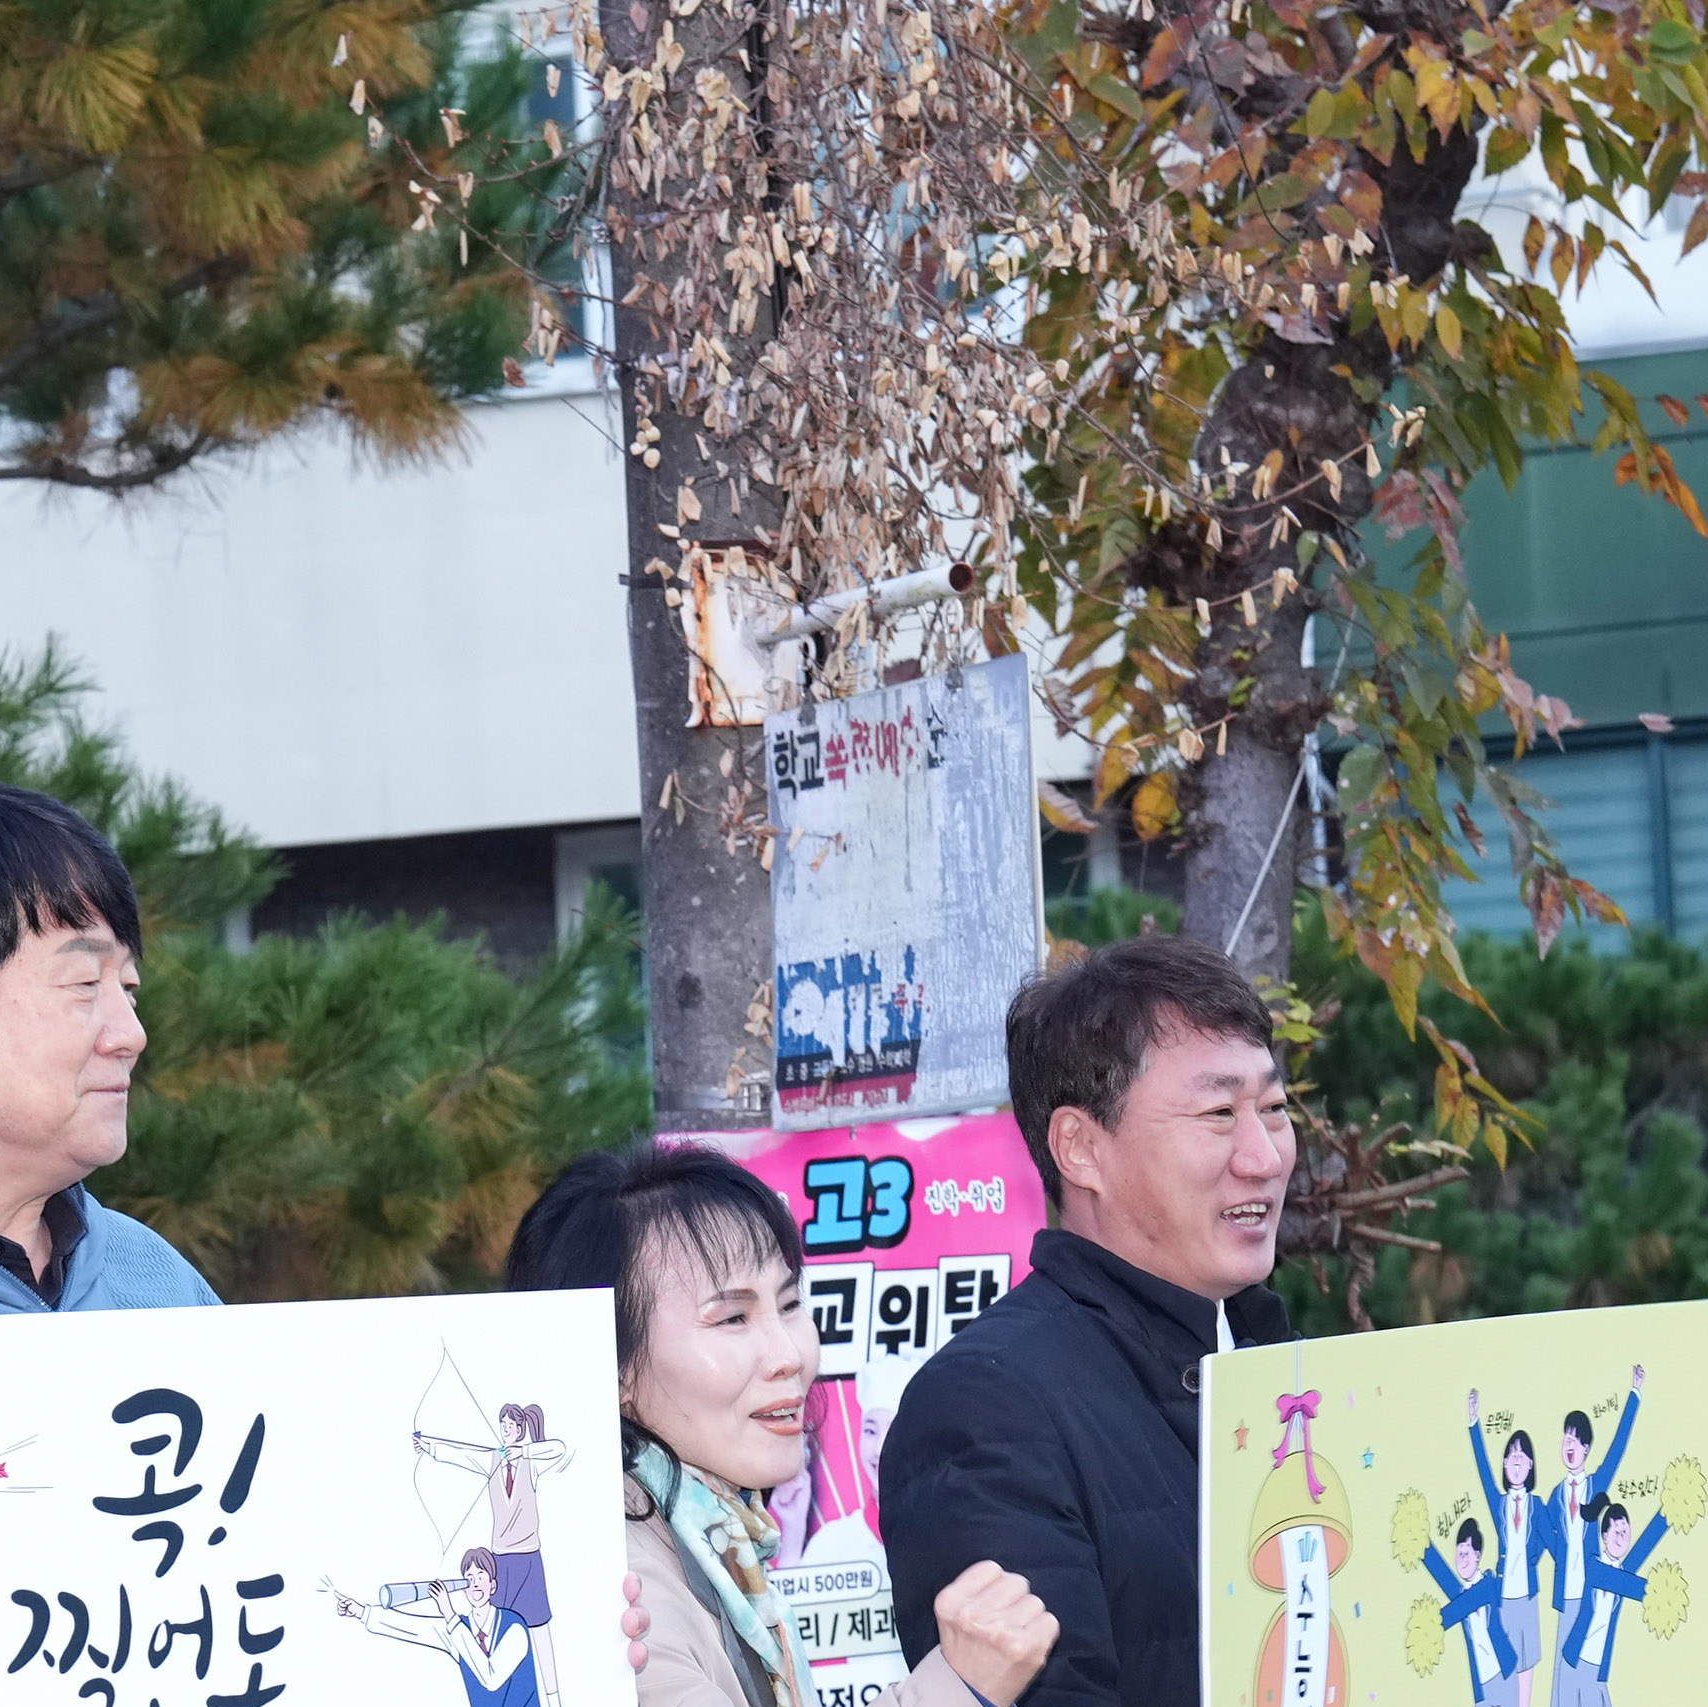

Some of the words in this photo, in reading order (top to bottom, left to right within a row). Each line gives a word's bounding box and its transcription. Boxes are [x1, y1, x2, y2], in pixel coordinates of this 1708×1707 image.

[804, 1155, 914, 1256] 고3
[925, 1177, 1005, 1216] 진학·취업
[1485, 1409, 1514, 1434] 응원해
[1593, 1393, 1619, 1418] 화이팅
[92, 1388, 266, 1577] 콕!
[1437, 1492, 1471, 1537] 힘내라
[815, 1570, 873, 1592] 500만원
